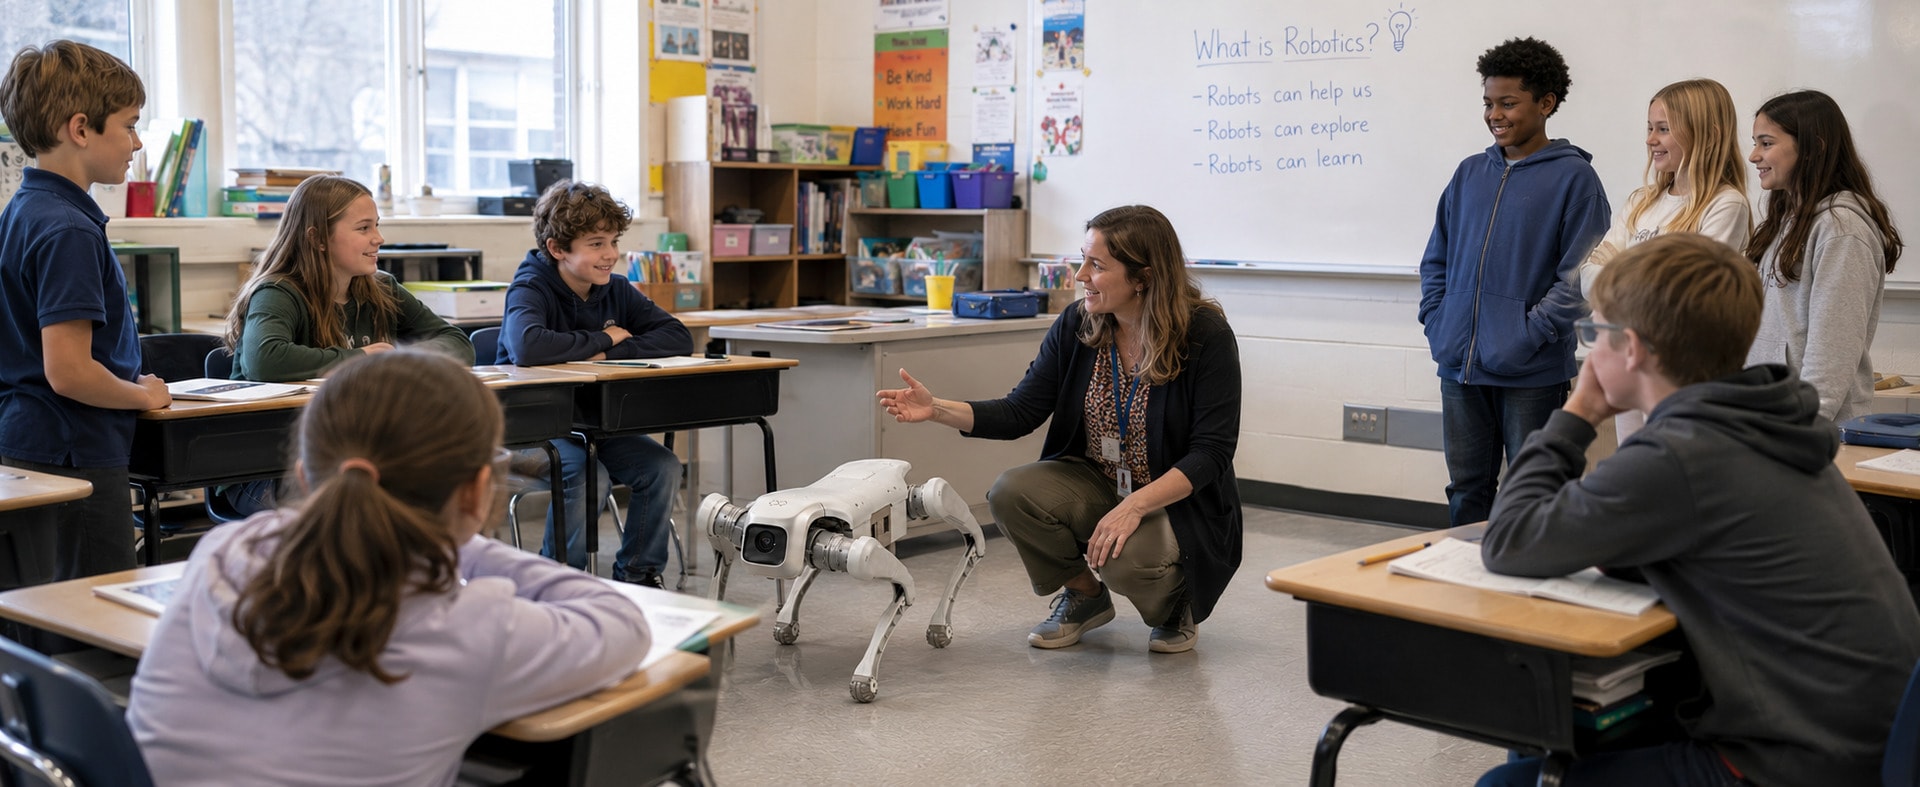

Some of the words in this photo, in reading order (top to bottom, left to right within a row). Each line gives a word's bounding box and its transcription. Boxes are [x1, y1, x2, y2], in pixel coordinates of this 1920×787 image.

[1193, 27, 1252, 60] What
[1258, 35, 1274, 57] is
[1283, 22, 1380, 55] Robotics?
[886, 69, 902, 85] Be
[906, 68, 932, 83] Kind
[886, 97, 912, 111] Work
[915, 95, 942, 110] Hard
[1207, 83, 1262, 107] Robots
[1273, 89, 1303, 103] can
[1309, 80, 1344, 107] help
[1352, 84, 1373, 99] us
[916, 122, 937, 137] Fun
[1207, 119, 1262, 141] Robots
[1274, 124, 1304, 138] can
[1310, 114, 1370, 142] explore
[1208, 152, 1263, 175] Robots
[1276, 156, 1307, 171] can
[1316, 147, 1363, 168] learn
